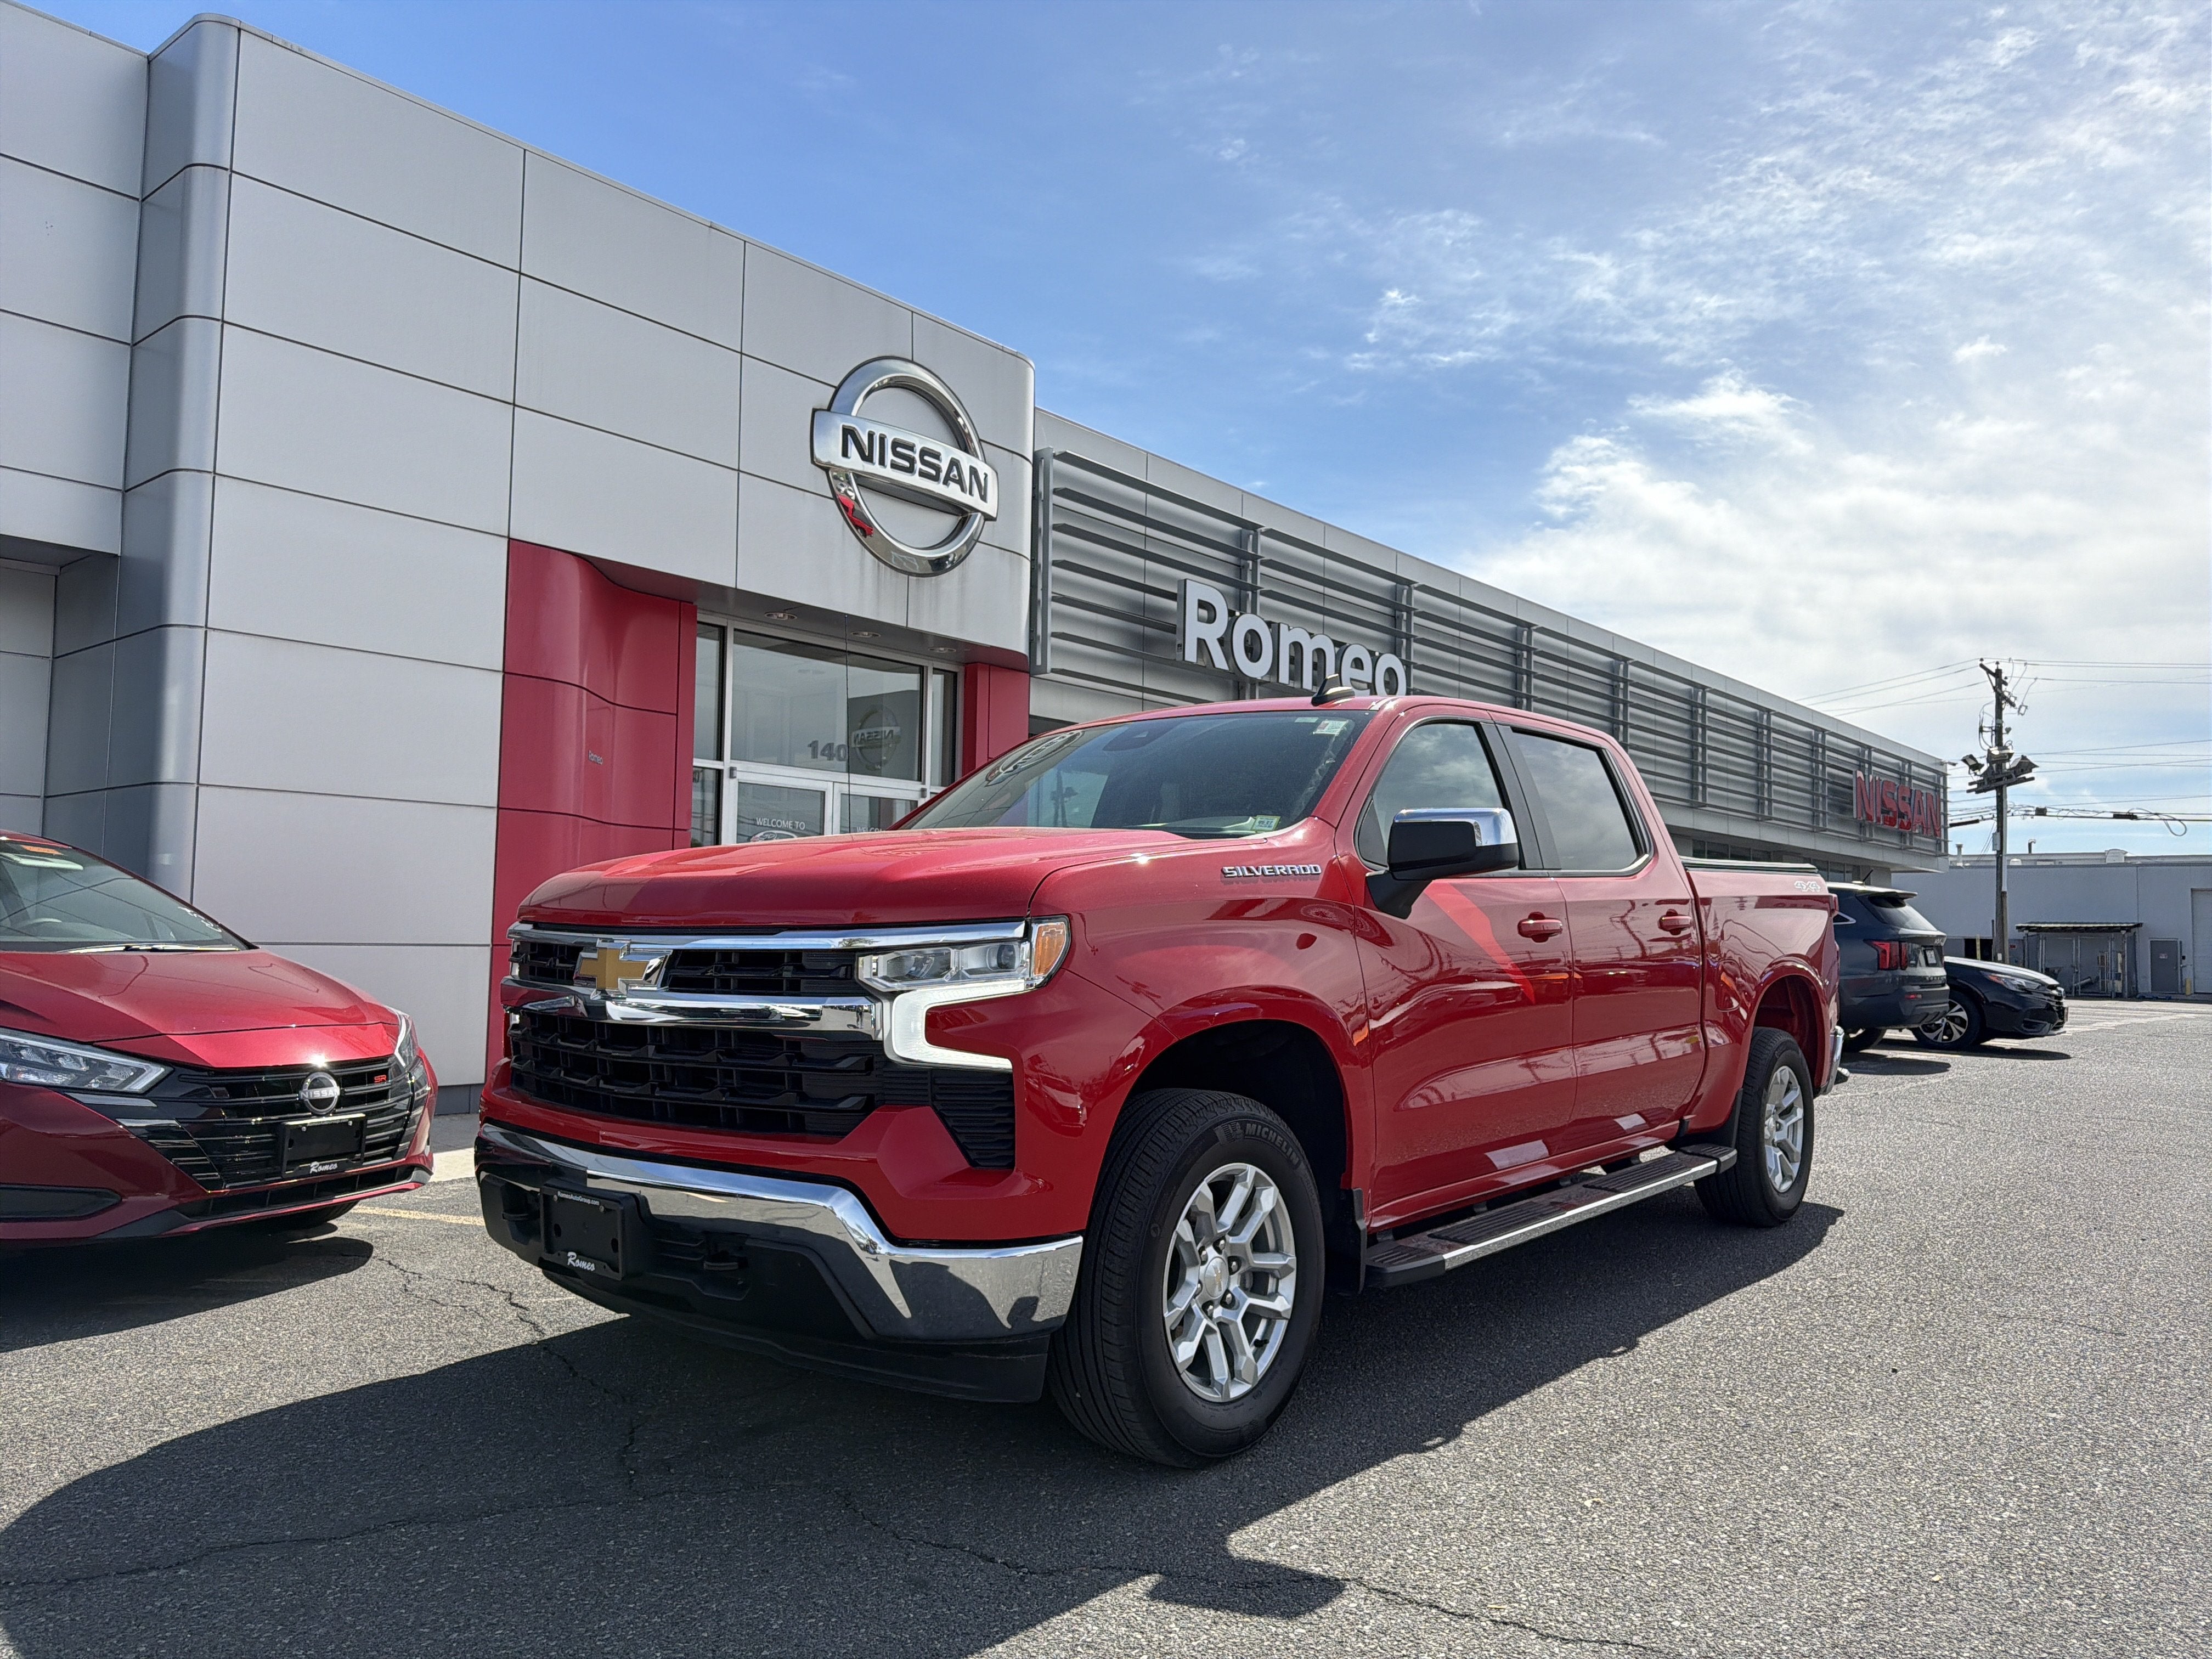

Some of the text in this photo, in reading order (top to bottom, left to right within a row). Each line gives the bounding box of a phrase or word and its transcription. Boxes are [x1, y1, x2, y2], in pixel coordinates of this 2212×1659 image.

[841, 424, 988, 504] NISSAN
[1177, 578, 1407, 696] Romeo
[1853, 770, 1942, 838] NISSAN
[756, 817, 805, 831] WELCOME TO
[1222, 864, 1322, 878] SILVERADO
[374, 1074, 387, 1084] SR
[301, 1087, 340, 1098] NISSAN
[1245, 1123, 1300, 1165] MICHELIN
[309, 1161, 338, 1173] Romeo
[567, 1251, 595, 1272] Romeo
